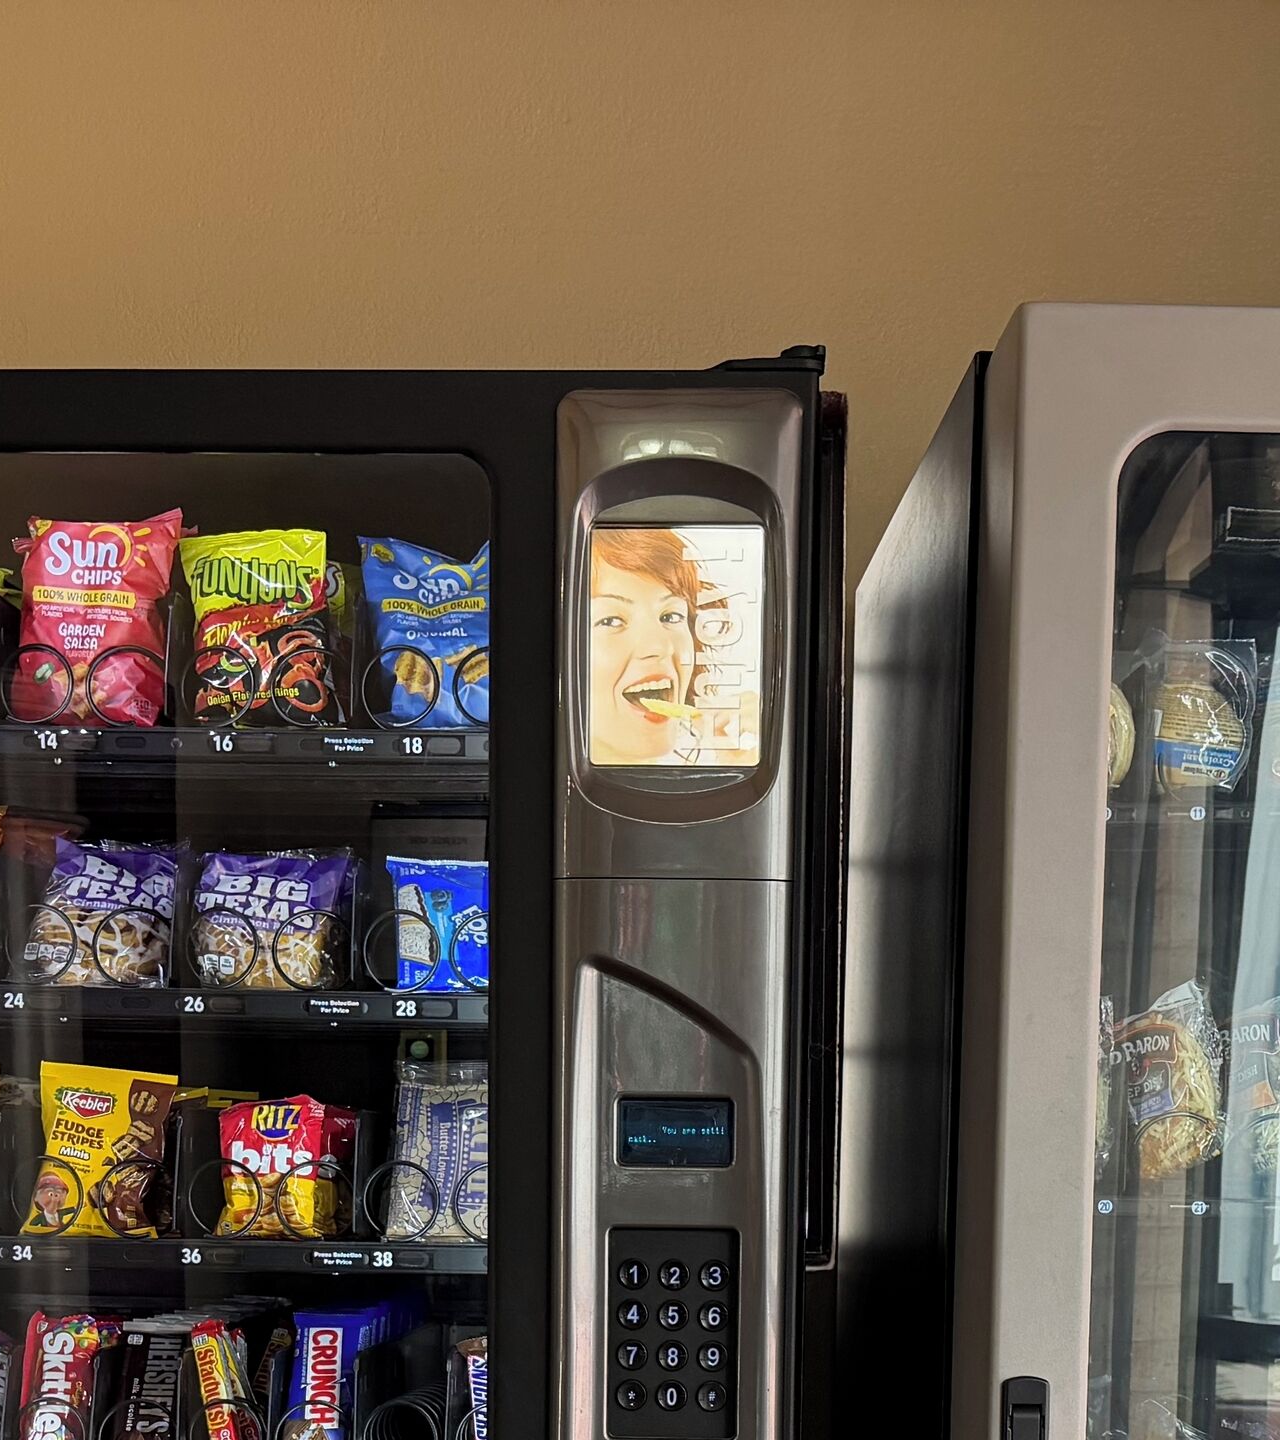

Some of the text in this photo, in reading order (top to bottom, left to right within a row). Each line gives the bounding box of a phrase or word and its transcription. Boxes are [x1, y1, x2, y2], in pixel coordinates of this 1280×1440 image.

[44, 531, 119, 576] Sun
[71, 570, 122, 586] CHIPS
[191, 557, 314, 610] FUNYUNS
[37, 589, 130, 605] 100% WHOLE GRAIN
[387, 599, 481, 618] 100% WHOLE GRAIN
[58, 622, 106, 637] GARDEN
[64, 637, 98, 650] SALSA
[38, 731, 57, 749] 14
[213, 736, 232, 751] 16
[403, 737, 422, 753] 18
[1192, 810, 1204, 818] 11
[82, 853, 176, 899] BIG
[65, 875, 174, 920] TEXAS
[214, 875, 310, 902] BIG
[199, 892, 315, 930] TEXAS
[4, 993, 24, 1008] 24
[185, 996, 204, 1012] 26
[396, 1001, 416, 1016] 28
[1122, 1034, 1171, 1063] BARON
[64, 1093, 111, 1113] Keebler
[251, 1105, 302, 1131] RITZ
[55, 1118, 105, 1139] FUDGE
[51, 1130, 104, 1150] STRIPES
[59, 1146, 91, 1160] Minis
[231, 1141, 313, 1176] bits
[436, 1121, 452, 1189] Butter Lovers
[1099, 1202, 1112, 1212] 20
[1194, 1203, 1206, 1212] 21
[13, 1246, 32, 1260] 34
[182, 1248, 201, 1263] 36
[373, 1252, 392, 1266] 38
[630, 1265, 721, 1285] 1 2 3
[626, 1305, 721, 1326] 4 5 6
[626, 1347, 720, 1366] 7 8 9
[136, 1336, 183, 1434] HERSHEY'S
[309, 1328, 340, 1426] CRUNCH
[666, 1388, 677, 1406] 0
